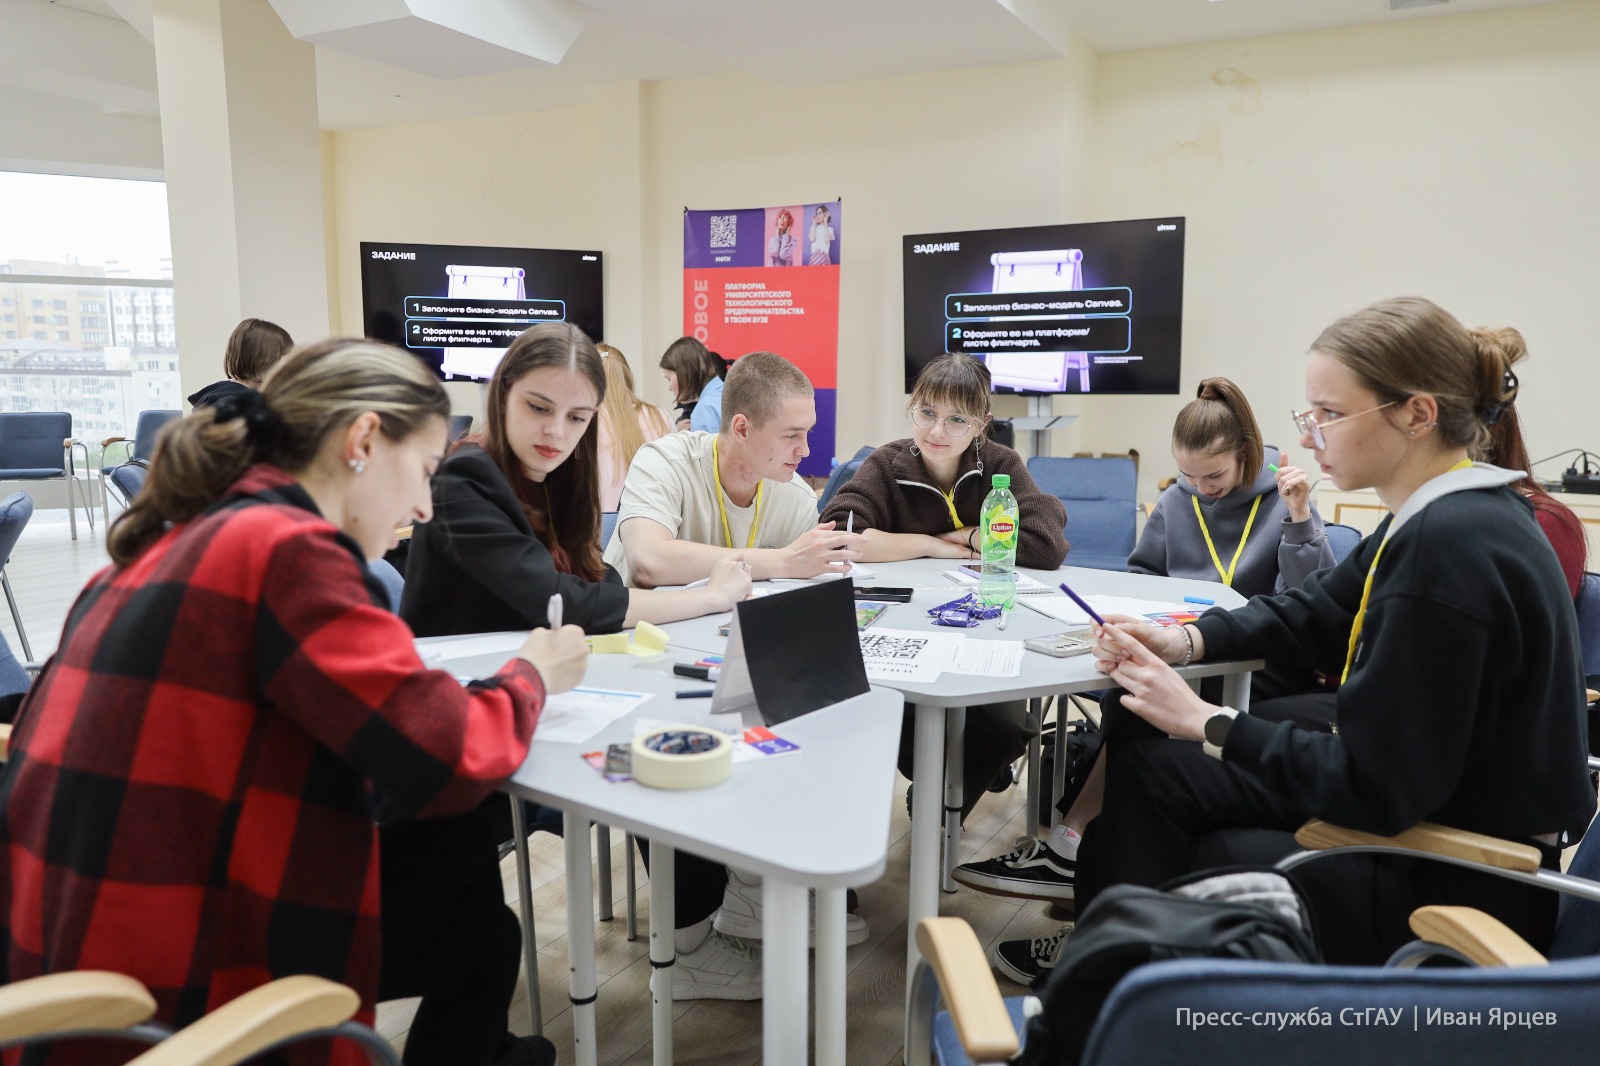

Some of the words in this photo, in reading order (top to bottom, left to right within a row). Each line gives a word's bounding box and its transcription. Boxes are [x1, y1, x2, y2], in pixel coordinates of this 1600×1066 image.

[913, 242, 960, 254] ЗАДАНИЕ
[371, 251, 416, 260] ЗАДАНИЕ
[413, 303, 420, 312] 1
[466, 307, 528, 315] бизнес-модель
[528, 308, 559, 316] Canvas.
[694, 280, 708, 343] ОВОЕ
[954, 302, 962, 312] 1
[962, 304, 1011, 312] Заполните
[1011, 302, 1084, 310] бизнес-модель
[1084, 300, 1123, 308] Canvas.
[412, 325, 420, 334] 2
[487, 329, 526, 337] платфор
[952, 328, 962, 338] 2
[962, 330, 1008, 339] Оформите
[448, 336, 493, 344] флипчарта.
[962, 340, 989, 348] листе
[989, 339, 1041, 348] флипчарта.
